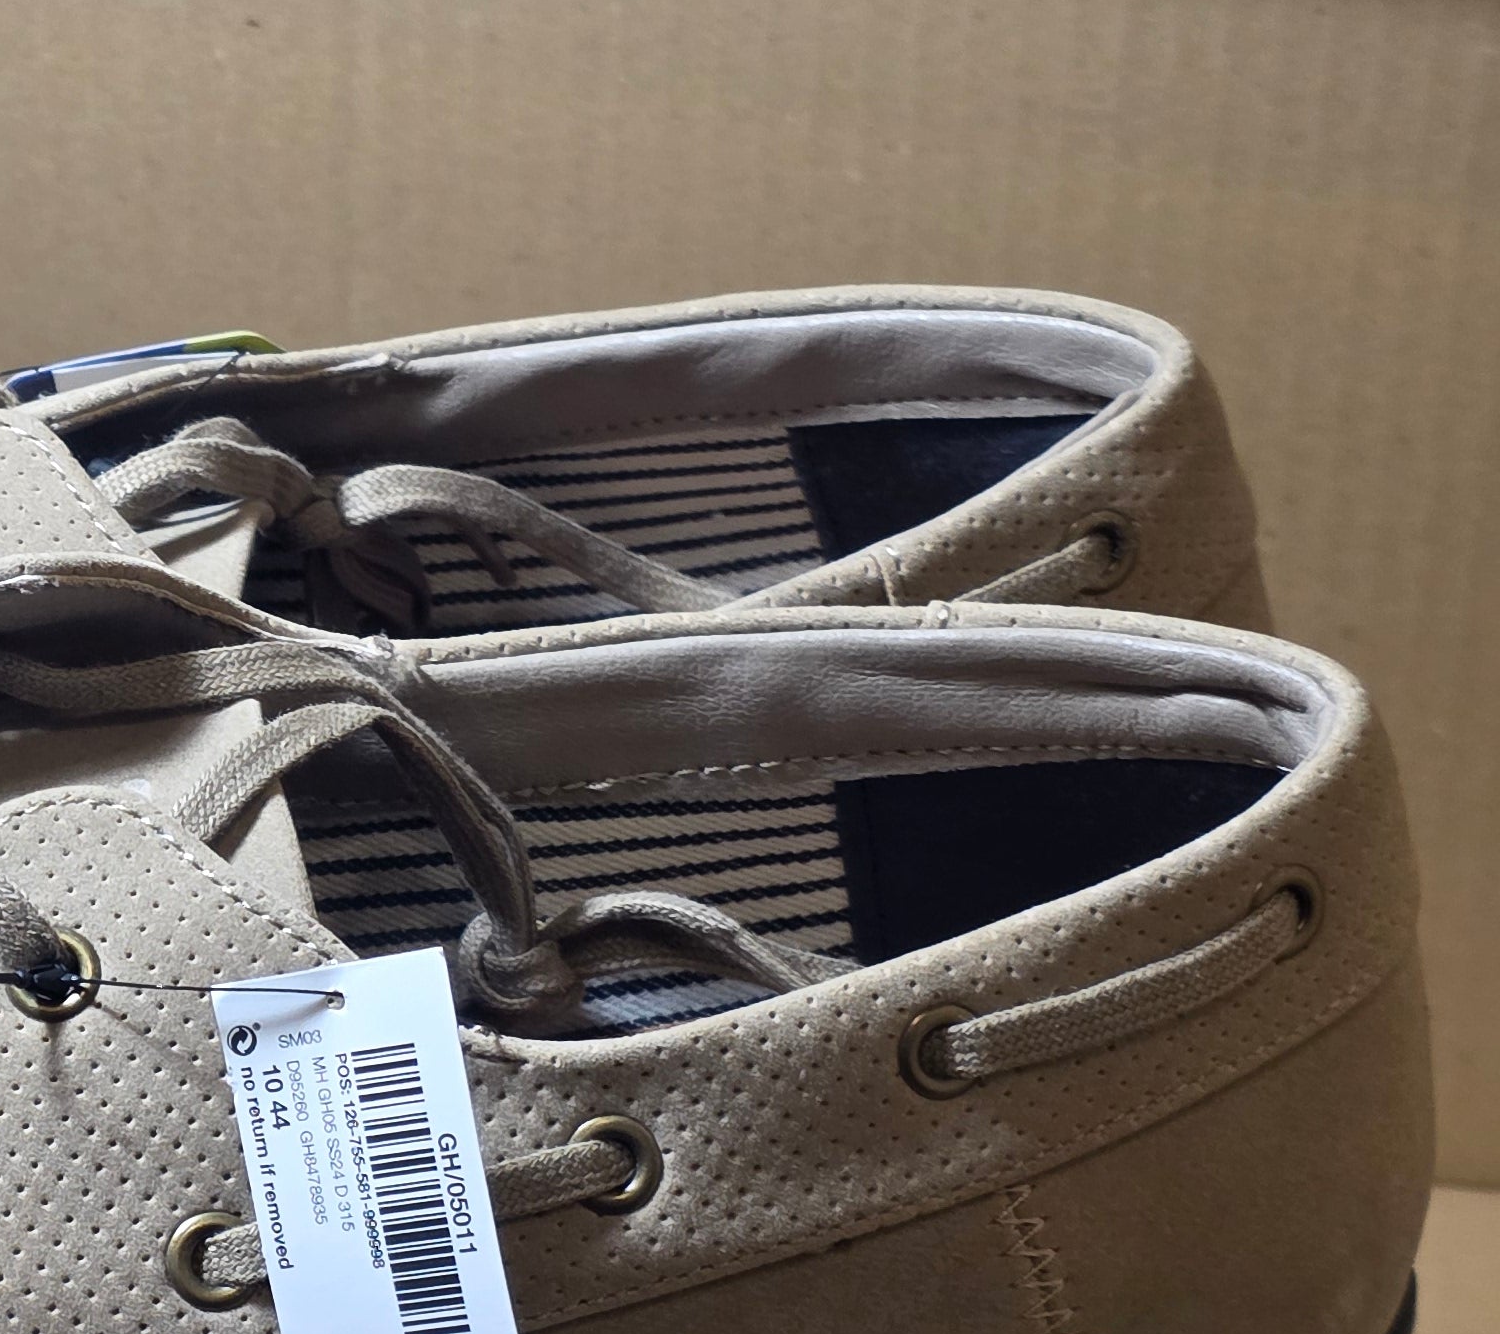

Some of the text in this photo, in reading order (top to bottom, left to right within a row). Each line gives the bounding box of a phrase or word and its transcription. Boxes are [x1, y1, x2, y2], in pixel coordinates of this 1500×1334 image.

[278, 1029, 322, 1048] SM03
[241, 1067, 255, 1091] no
[262, 1065, 291, 1130] 10 44
[335, 1053, 352, 1095] POS:
[247, 1097, 268, 1158] return
[286, 1060, 328, 1225] D95260 GH8478935
[312, 1056, 355, 1232] MH GH05 SS24 D 315
[263, 1182, 294, 1269] removed
[438, 1133, 477, 1253] GH/05011
